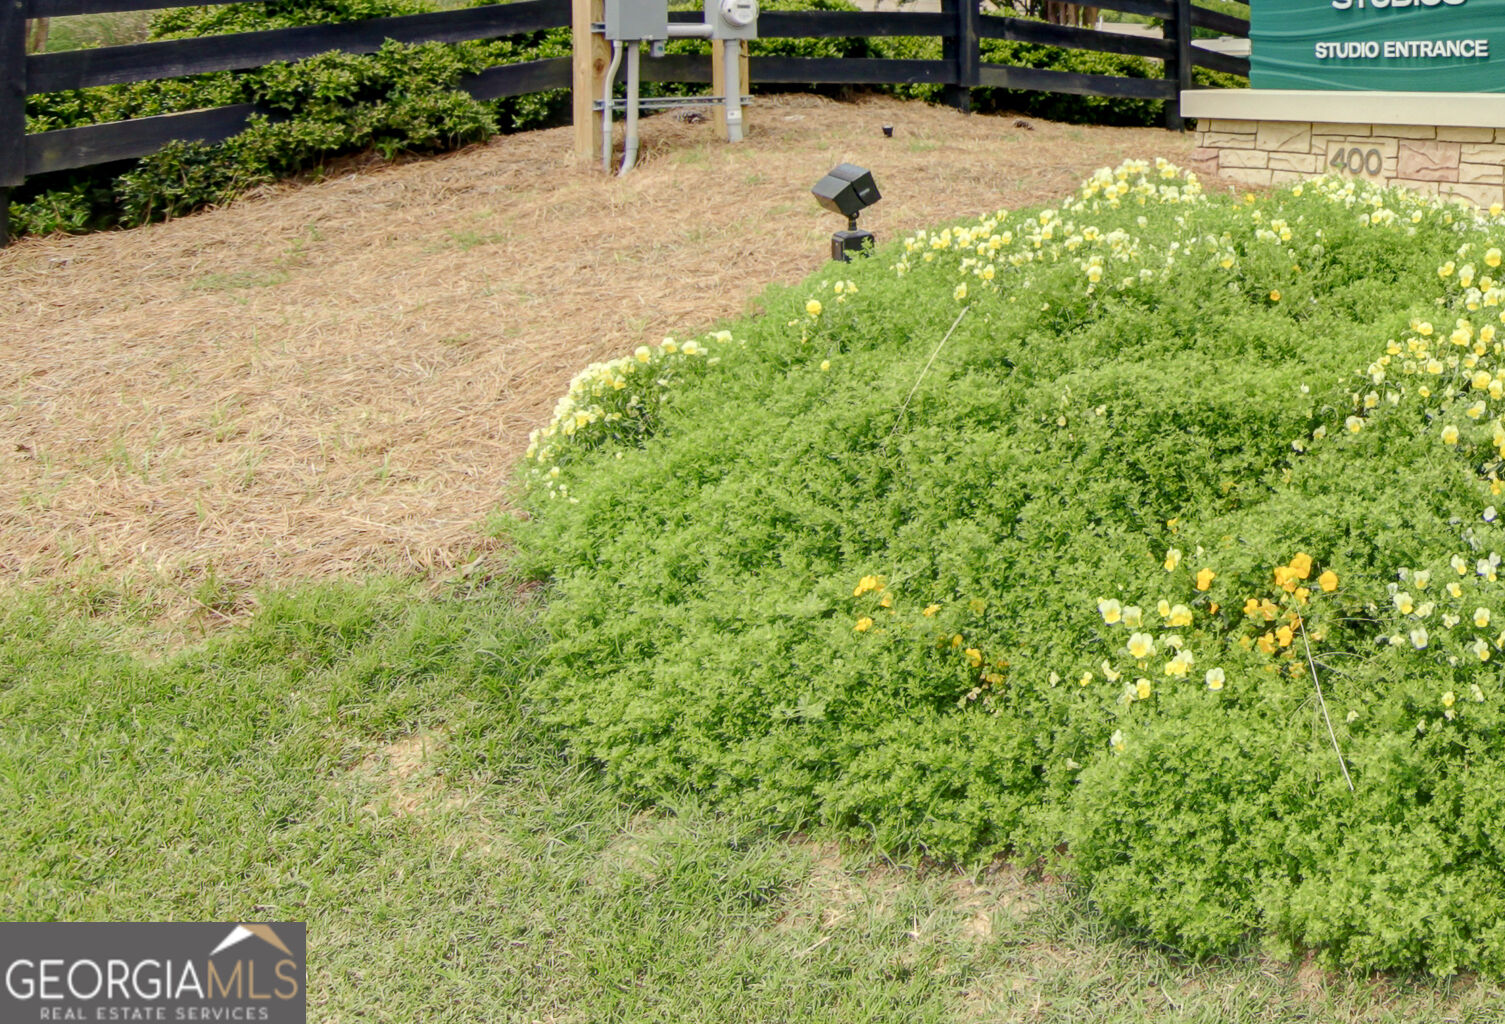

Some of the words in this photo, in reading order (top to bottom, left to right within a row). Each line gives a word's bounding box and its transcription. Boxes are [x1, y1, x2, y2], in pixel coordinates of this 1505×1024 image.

[1314, 41, 1380, 59] STUDIO
[1383, 39, 1489, 58] ENTRANCE
[1329, 147, 1383, 176] 400
